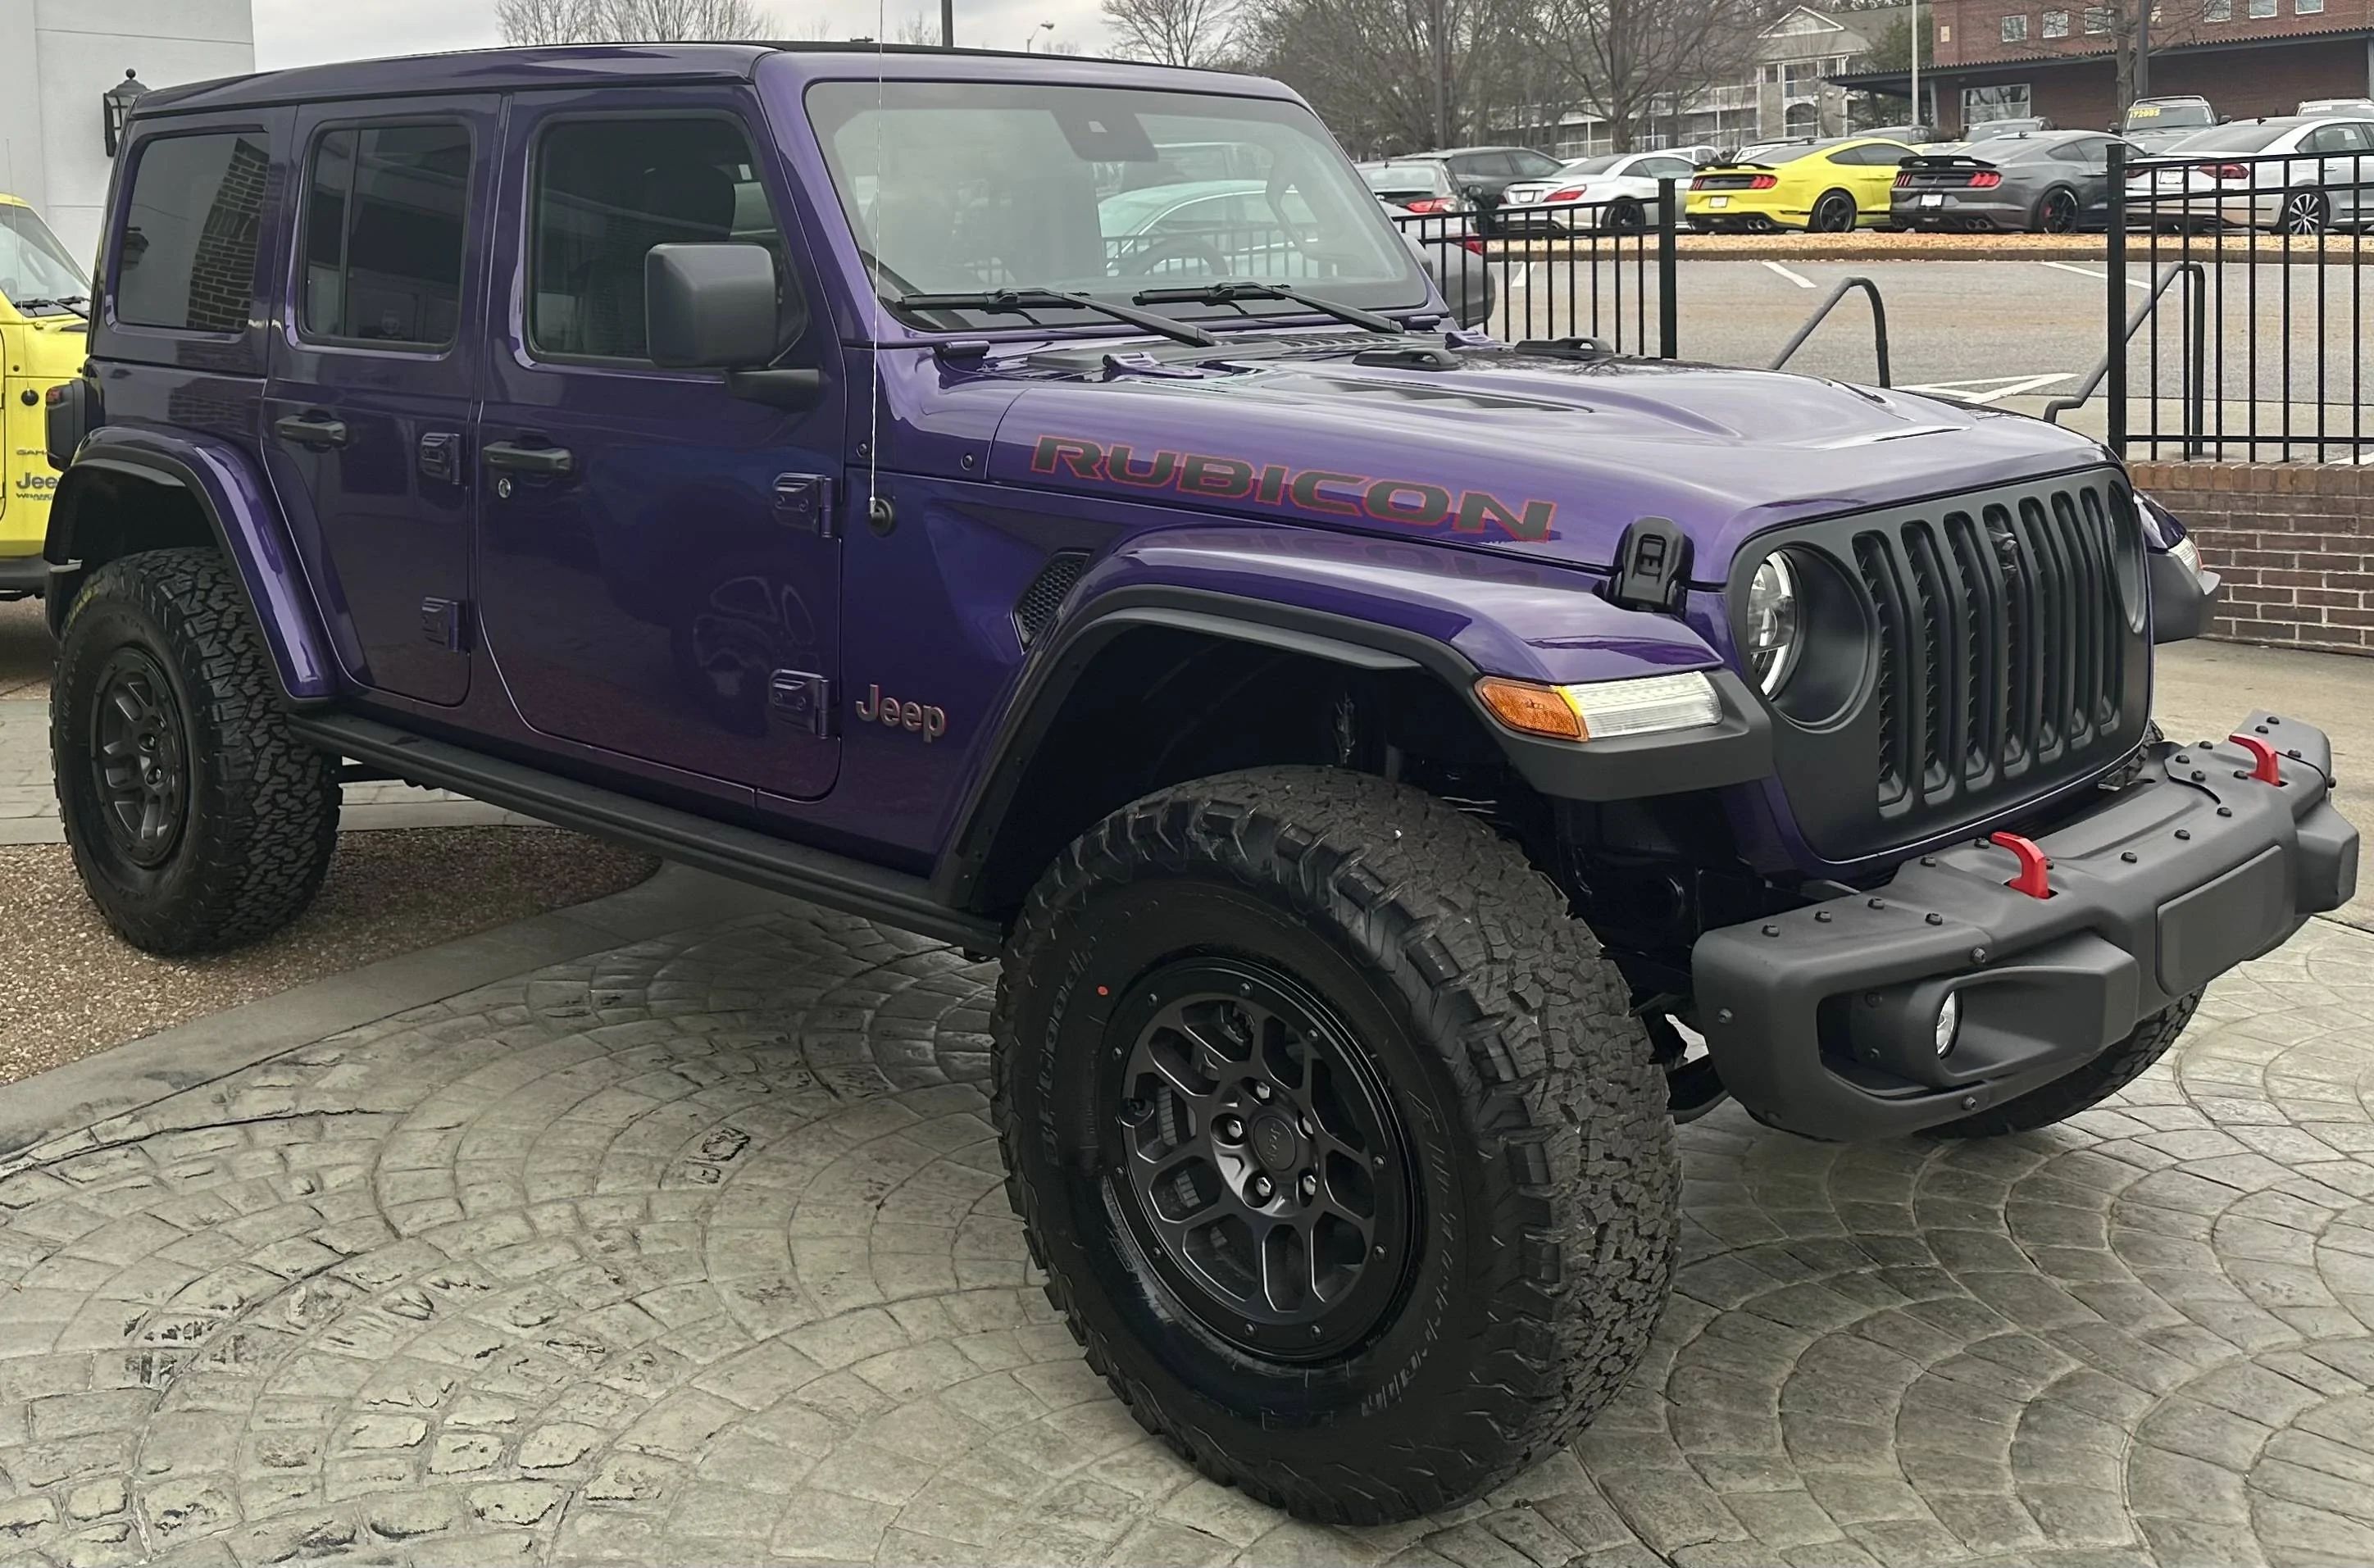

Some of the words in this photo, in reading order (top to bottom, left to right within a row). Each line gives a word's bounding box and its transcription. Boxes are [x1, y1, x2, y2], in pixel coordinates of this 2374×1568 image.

[16, 471, 57, 489] Jee
[1030, 435, 1556, 543] RUBICON
[855, 684, 945, 743] Jeep
